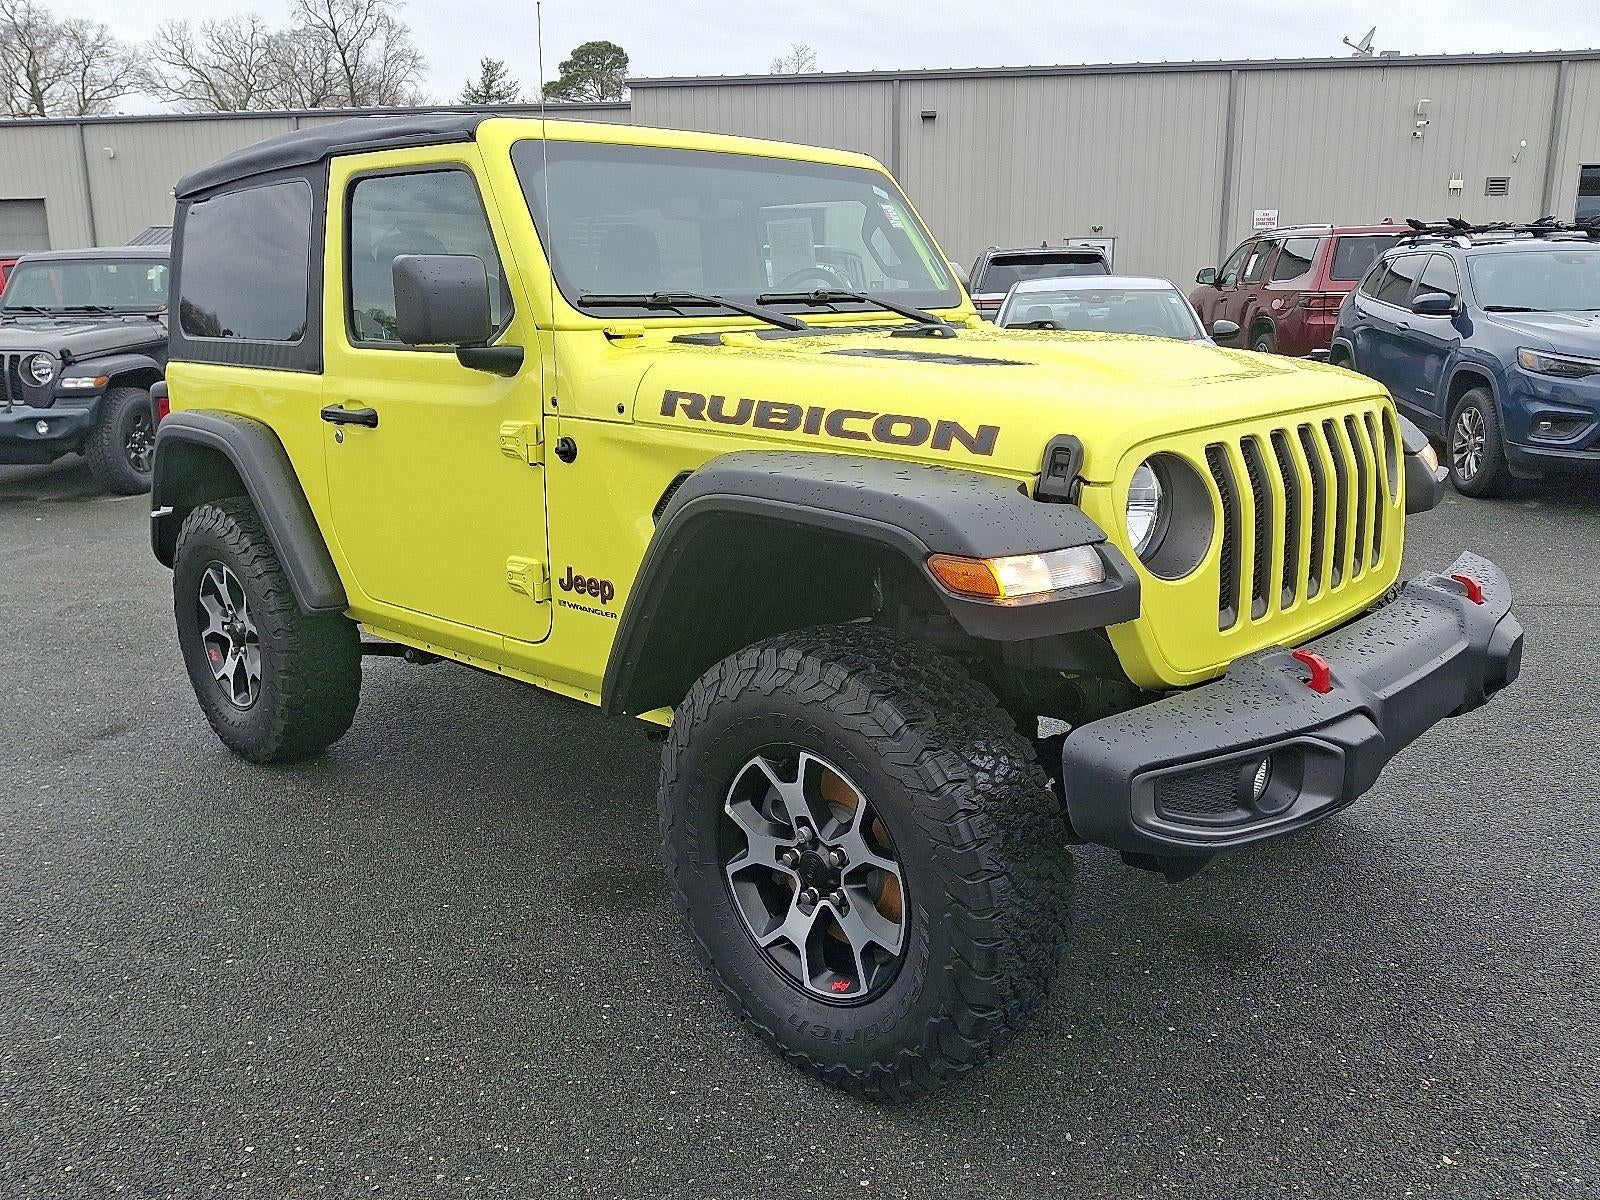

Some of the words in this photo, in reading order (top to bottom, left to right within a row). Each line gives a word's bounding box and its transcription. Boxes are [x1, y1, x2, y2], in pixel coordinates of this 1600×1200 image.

[660, 389, 1000, 456] RUBICON
[558, 565, 615, 605] Jeep
[566, 601, 618, 620] WRANGLER
